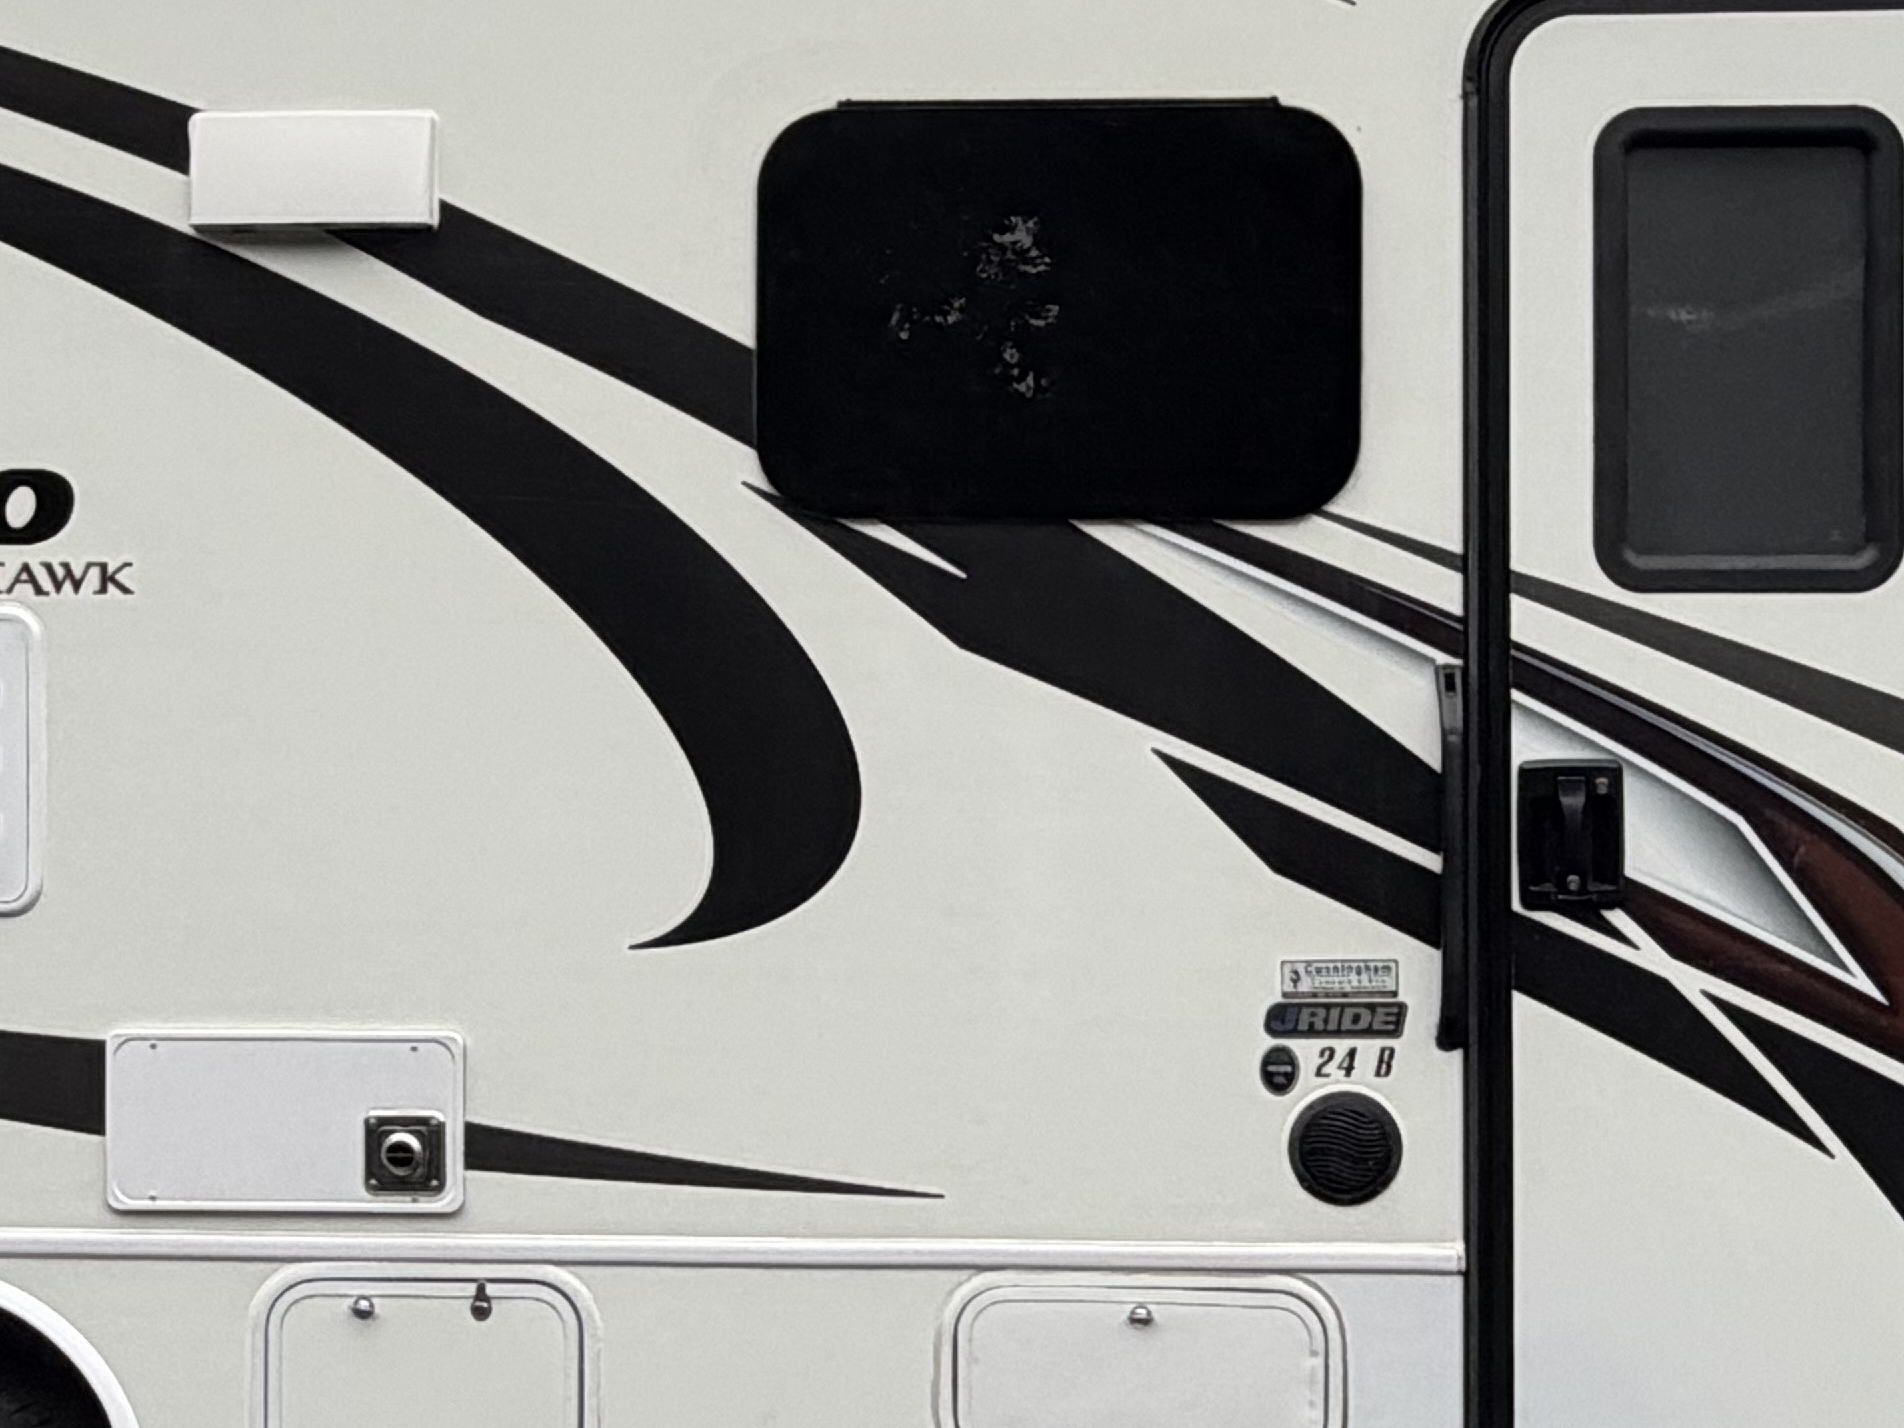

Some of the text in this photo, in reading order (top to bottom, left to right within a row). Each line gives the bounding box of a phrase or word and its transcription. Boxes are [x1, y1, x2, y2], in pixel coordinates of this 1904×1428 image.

[1269, 1006, 1400, 1032] JRIDE
[1314, 1046, 1358, 1078] 24
[1374, 1046, 1396, 1078] B
